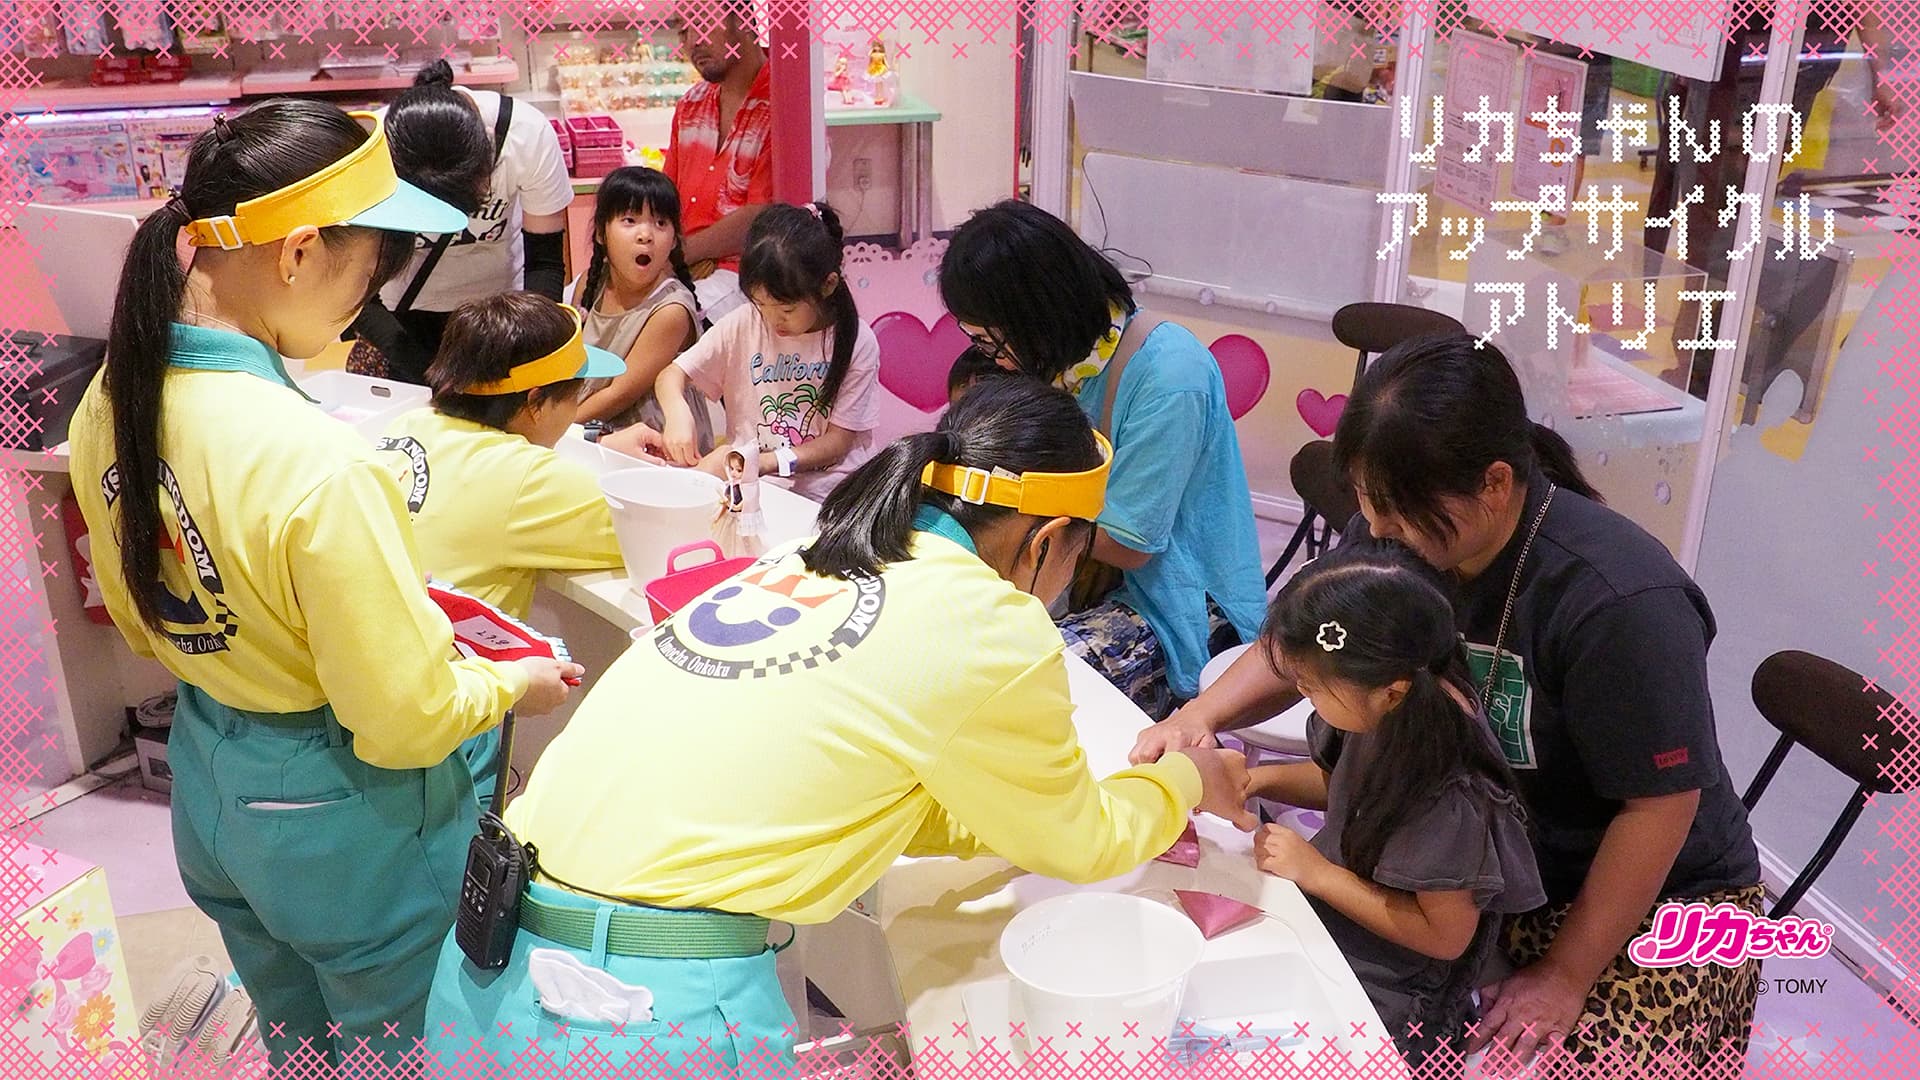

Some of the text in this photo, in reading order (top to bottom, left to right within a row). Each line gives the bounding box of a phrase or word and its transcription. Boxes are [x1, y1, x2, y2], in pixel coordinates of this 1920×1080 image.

[750, 353, 832, 386] Californ
[657, 635, 731, 678] Omocha Oukoku
